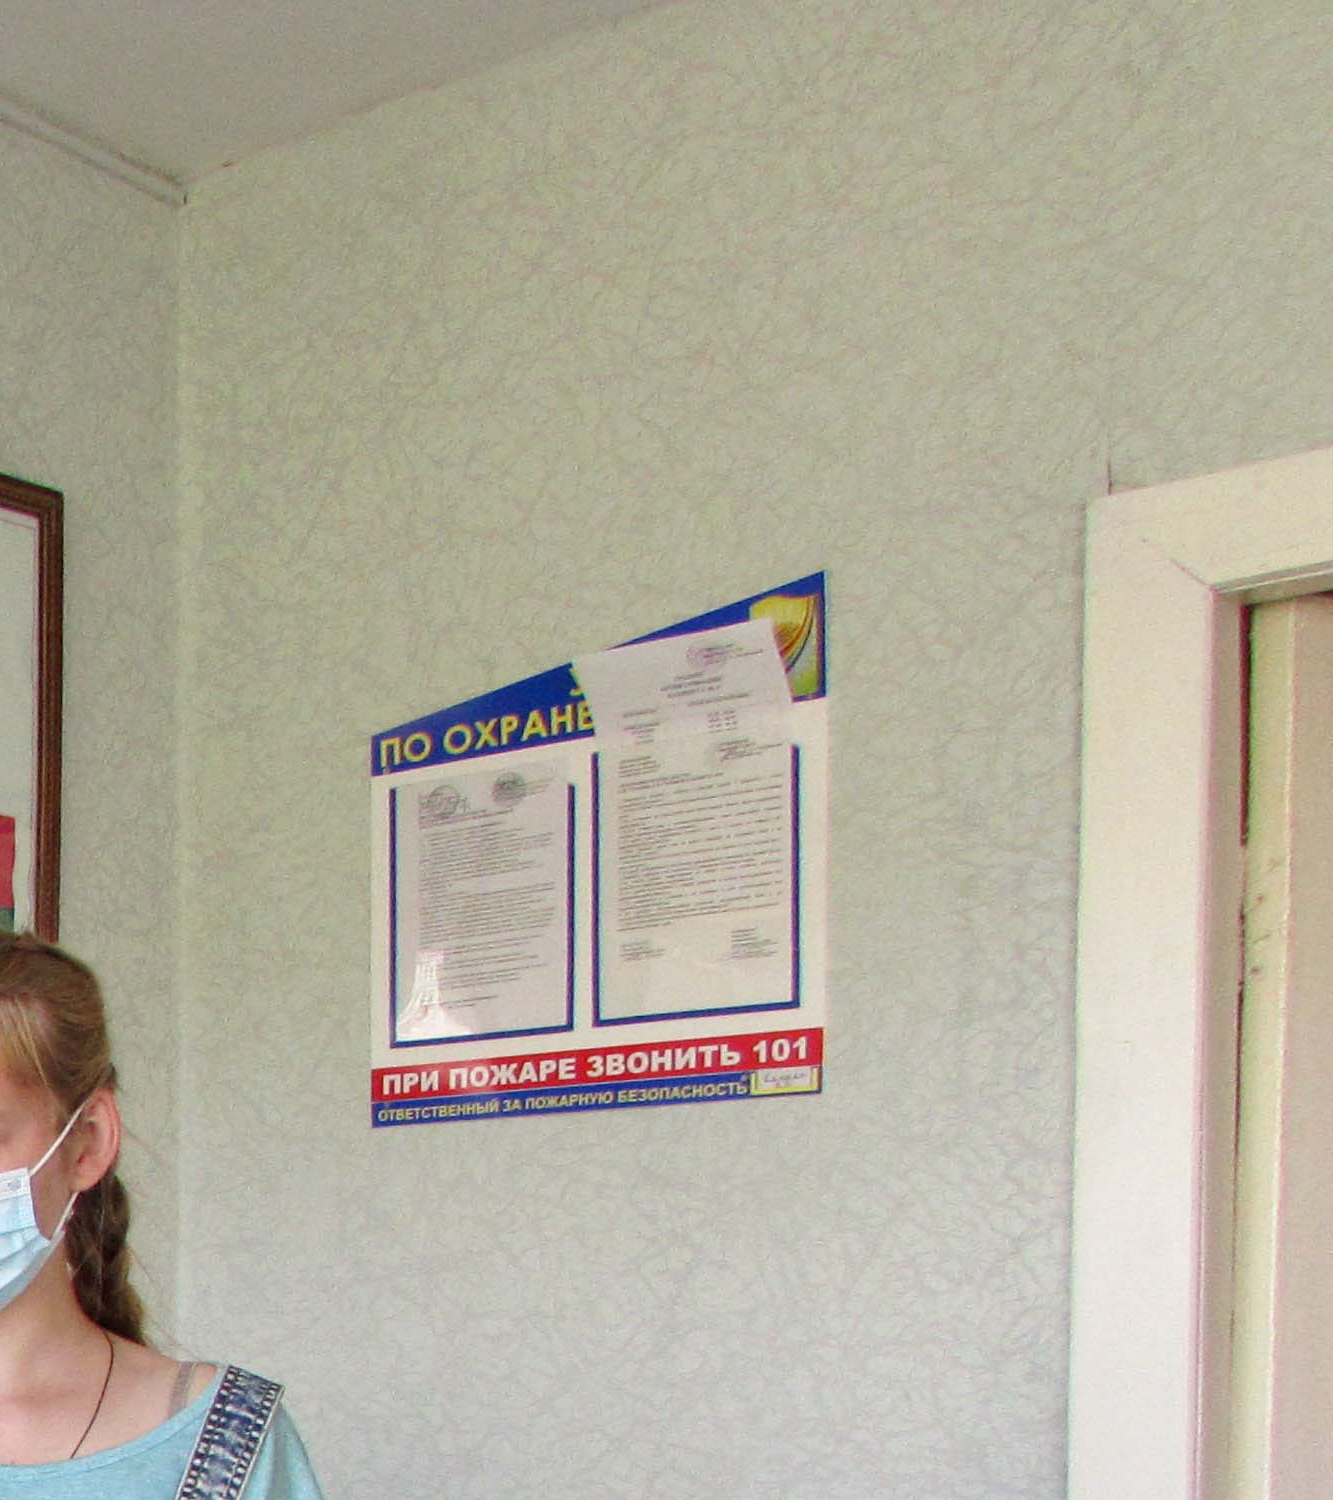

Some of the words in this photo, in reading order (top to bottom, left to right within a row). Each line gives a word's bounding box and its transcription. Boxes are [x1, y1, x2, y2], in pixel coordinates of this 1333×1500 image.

[380, 732, 432, 768] ПО
[382, 1071, 439, 1097] ПРИ
[448, 1059, 577, 1090] ПОЖАРЕ
[586, 1044, 741, 1078] ЗВОНИТЬ
[752, 1035, 809, 1063] 101
[377, 1097, 500, 1123] ОТВЕТСТВЕННЫЙ
[502, 1098, 522, 1112] ЗА
[525, 1089, 613, 1111] ПОЖАРНУЮ
[616, 1081, 748, 1104] БЕЗОПАСНОСТЬ
